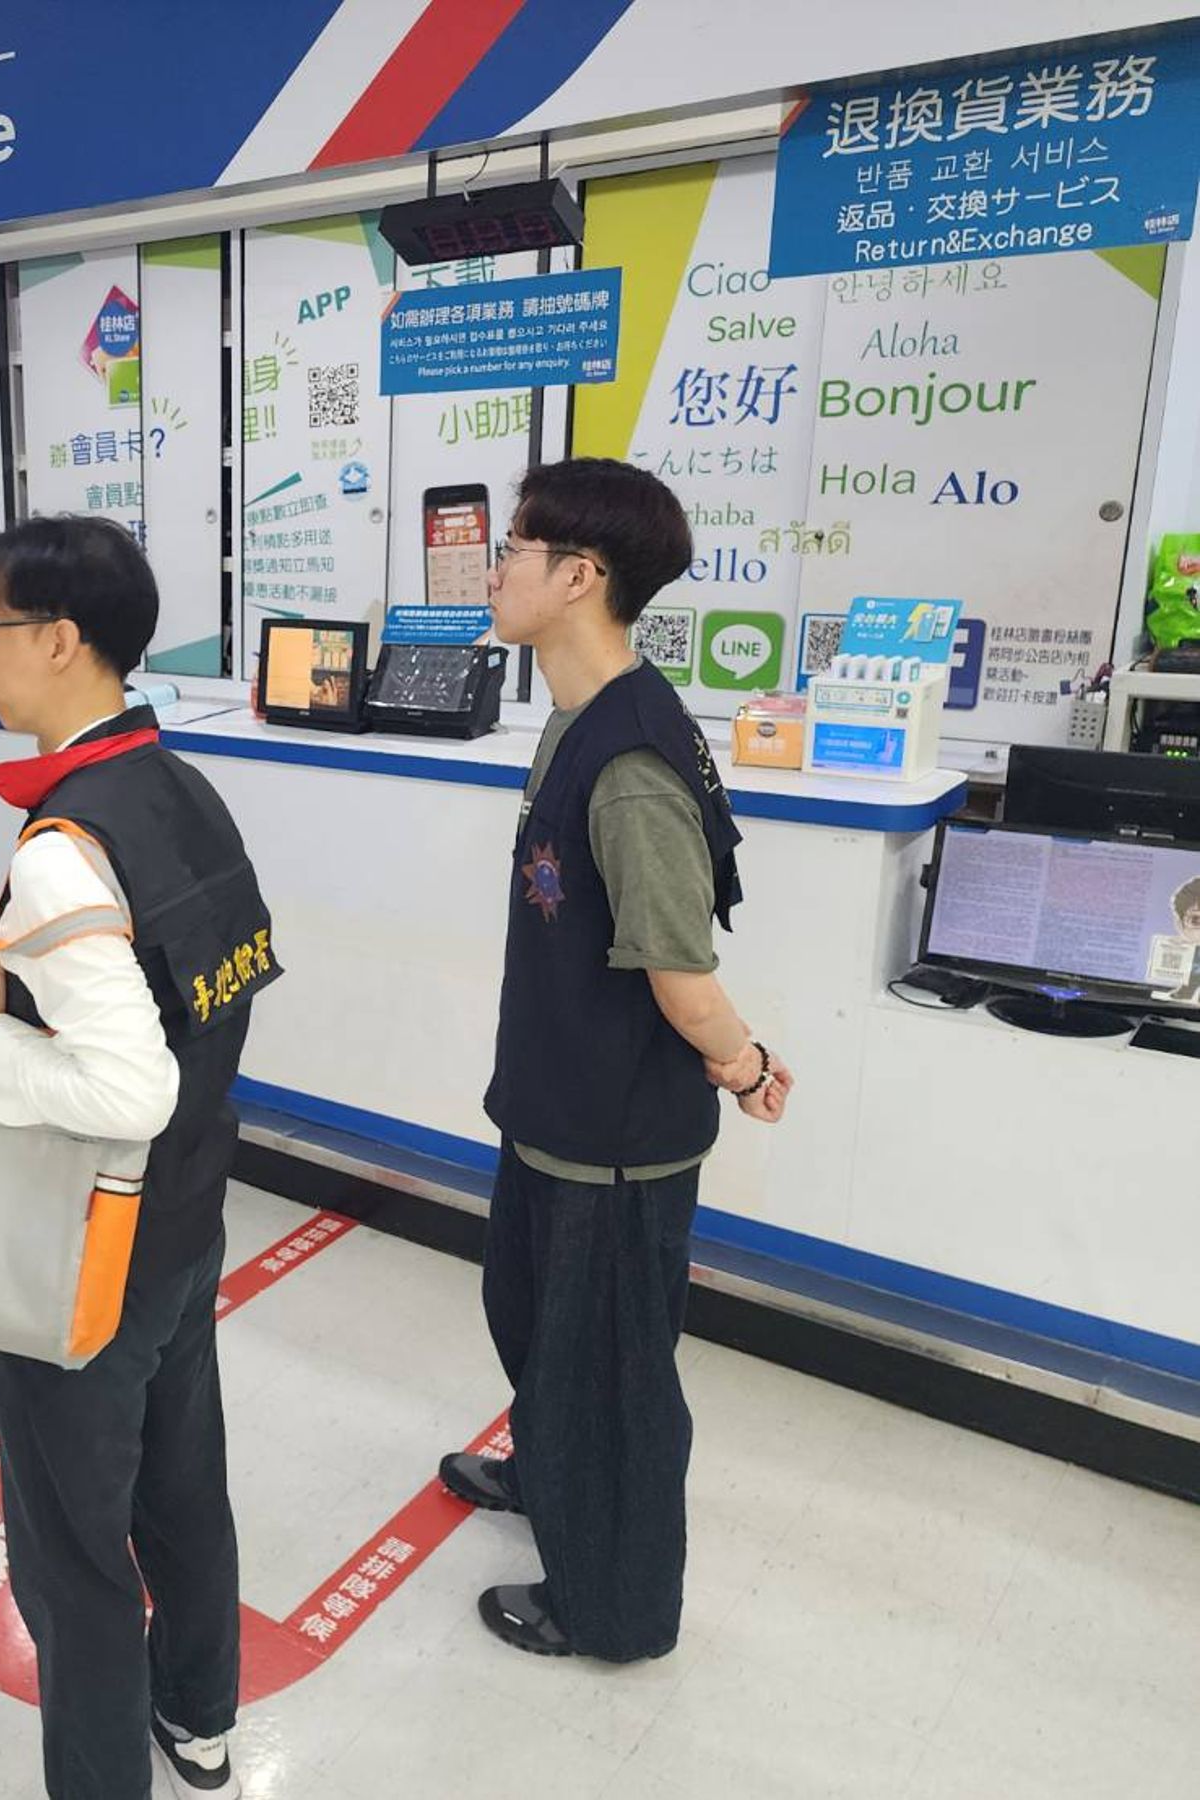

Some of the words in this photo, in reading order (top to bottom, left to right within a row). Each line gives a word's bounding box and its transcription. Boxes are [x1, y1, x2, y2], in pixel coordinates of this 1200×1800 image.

[822, 54, 1158, 158] 退換貨業務
[856, 159, 913, 194] 반품
[931, 149, 993, 183] 교환
[1010, 136, 1110, 174] 서비스
[855, 222, 1094, 264] Return&Exchange
[687, 263, 772, 297] Ciao
[831, 262, 1008, 303] 안녕하세요
[298, 285, 351, 324] APP
[707, 312, 797, 343] Salve
[860, 321, 960, 361] Aloha
[669, 362, 799, 427] 您好
[819, 372, 1037, 426] Bonjour
[820, 463, 916, 496] Hola
[931, 470, 1020, 505] Alo
[688, 548, 767, 584] ello
[721, 639, 762, 657] LINE
